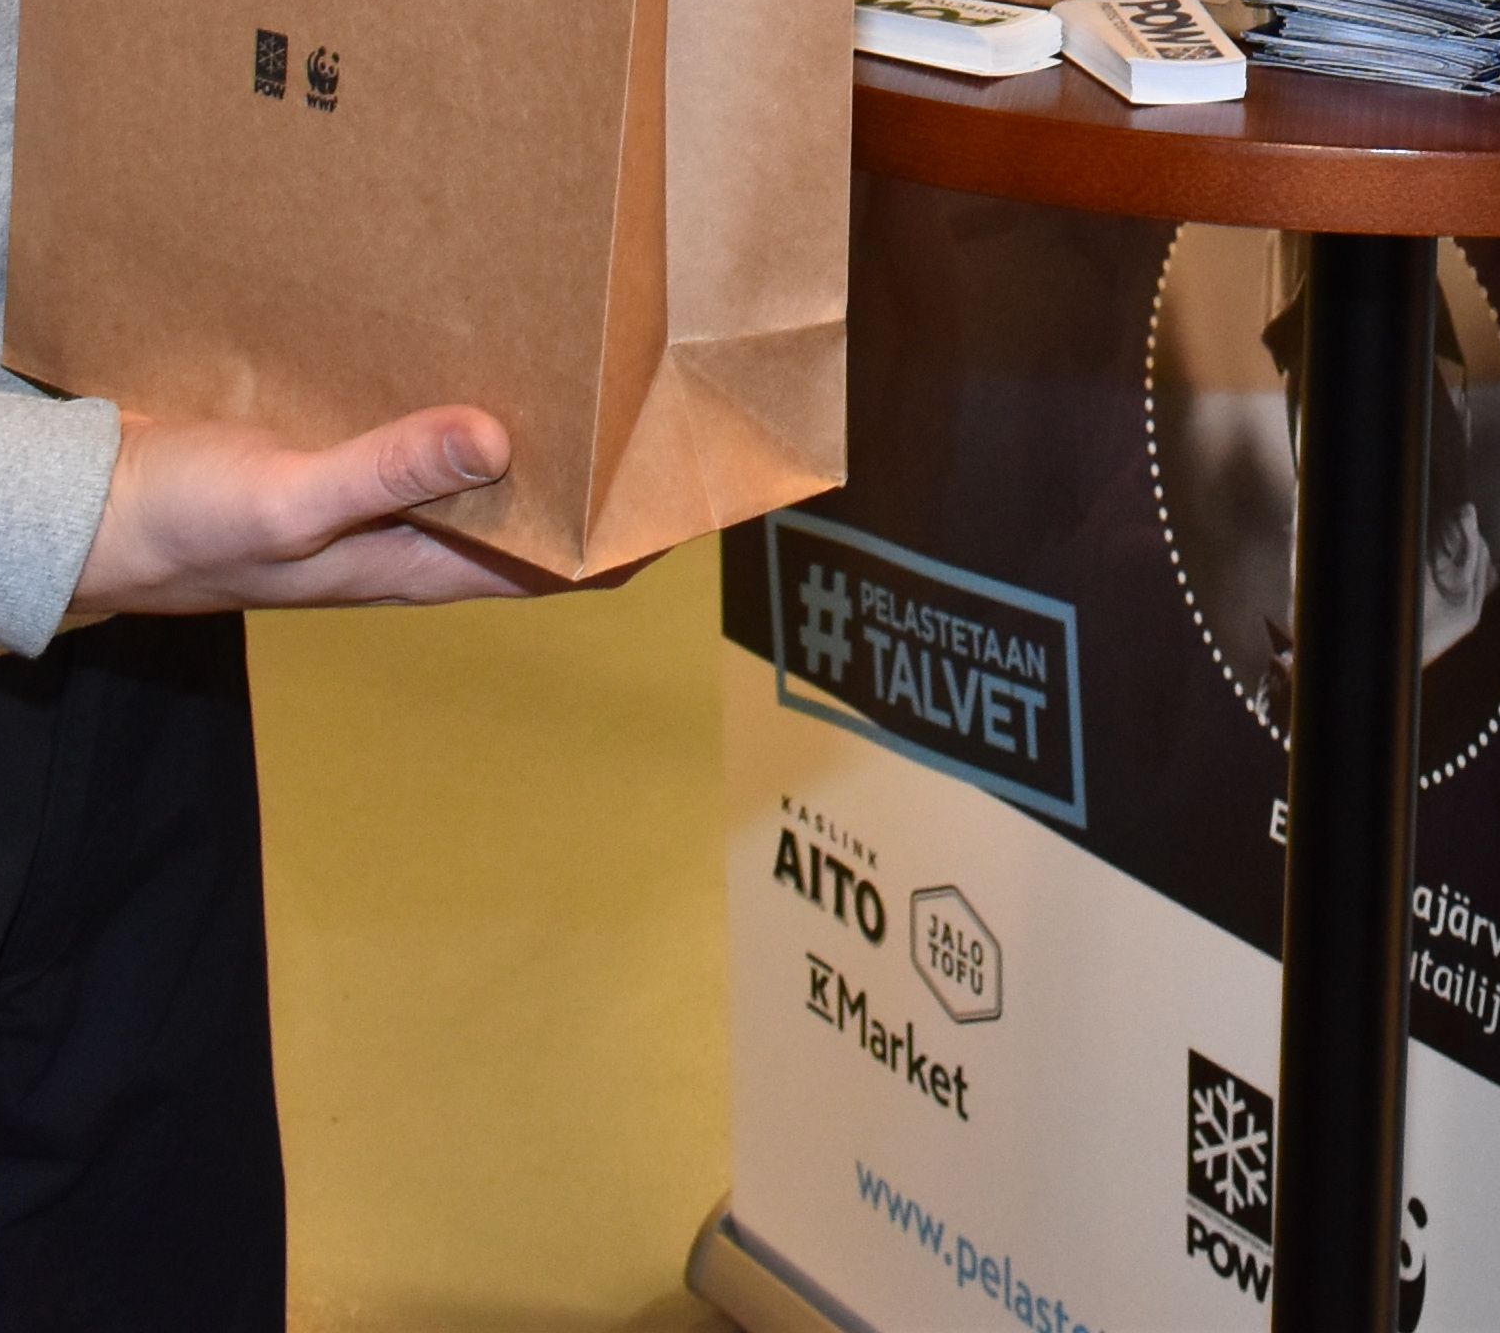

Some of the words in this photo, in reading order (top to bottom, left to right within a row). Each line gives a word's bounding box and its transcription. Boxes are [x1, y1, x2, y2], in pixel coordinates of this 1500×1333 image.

[860, 579, 1047, 682] PELASTETAAN
[863, 627, 1047, 761] TALVET
[780, 794, 879, 870] KASLINK
[773, 827, 886, 946] AITO
[928, 913, 984, 967] JALO
[928, 941, 984, 997] TOFU
[1187, 1213, 1271, 1303] POW
